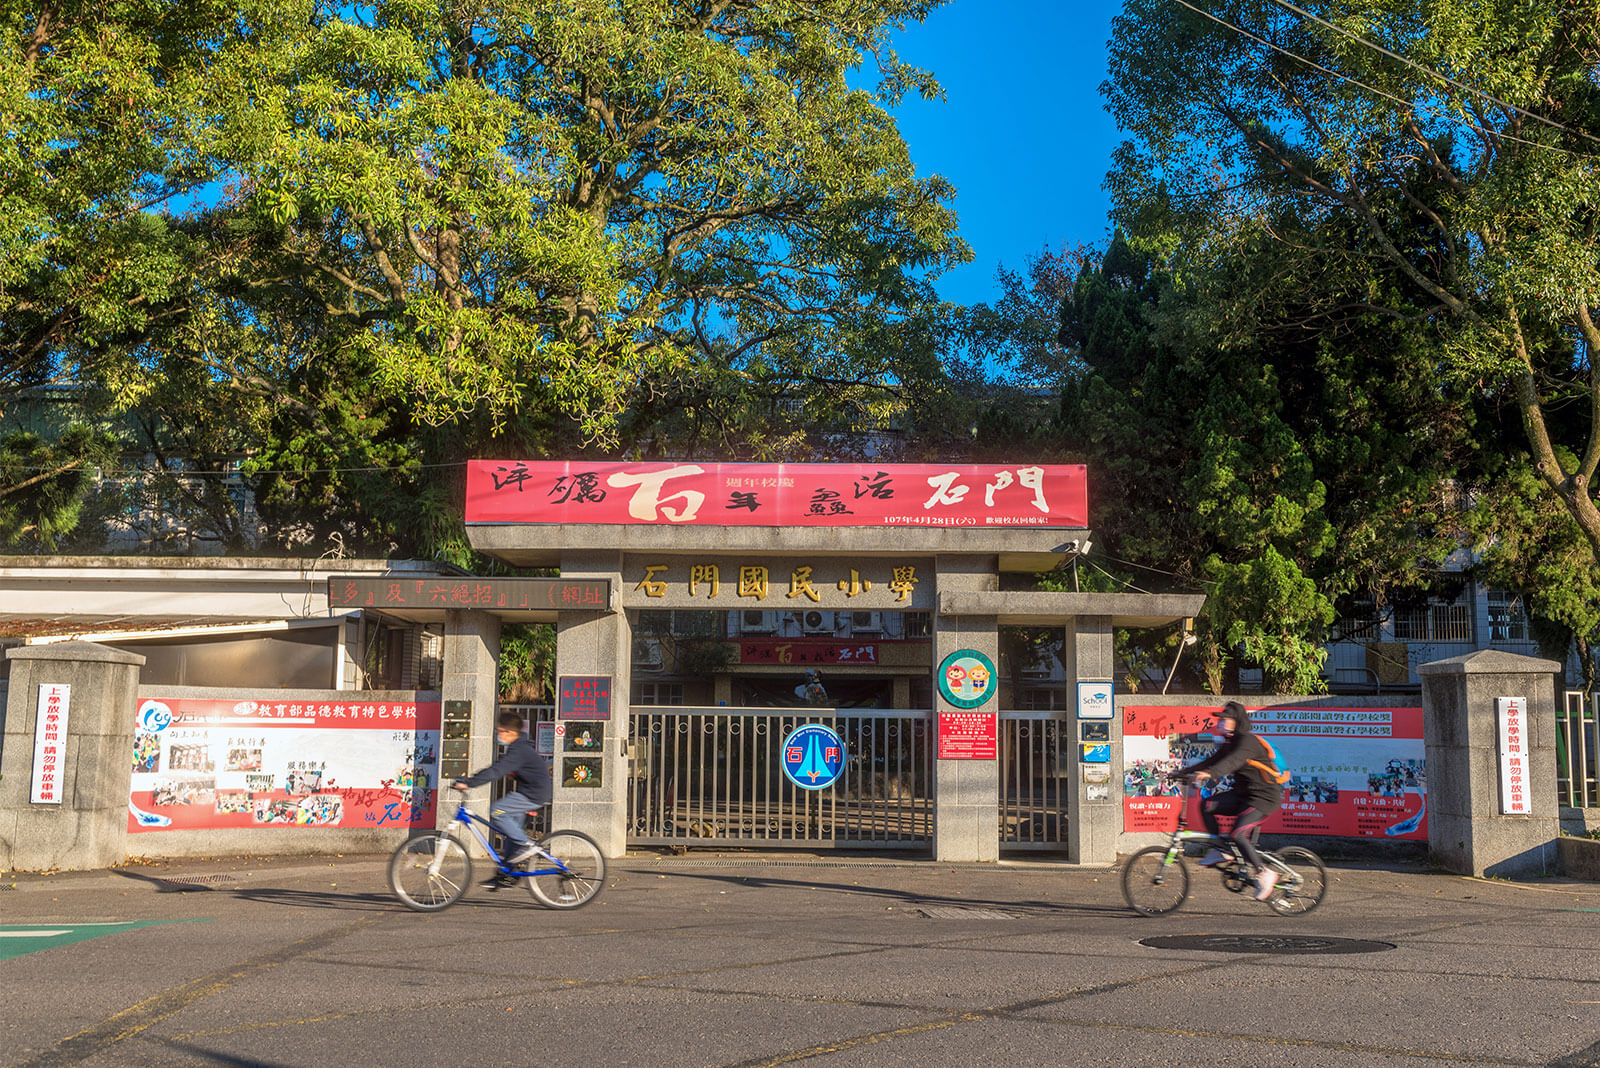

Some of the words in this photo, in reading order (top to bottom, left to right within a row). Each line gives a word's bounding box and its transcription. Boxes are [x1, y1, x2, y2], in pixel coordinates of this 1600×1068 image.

[635, 564, 920, 602] 石門國民小學
[258, 703, 417, 719] 教育部品德教育特色學校
